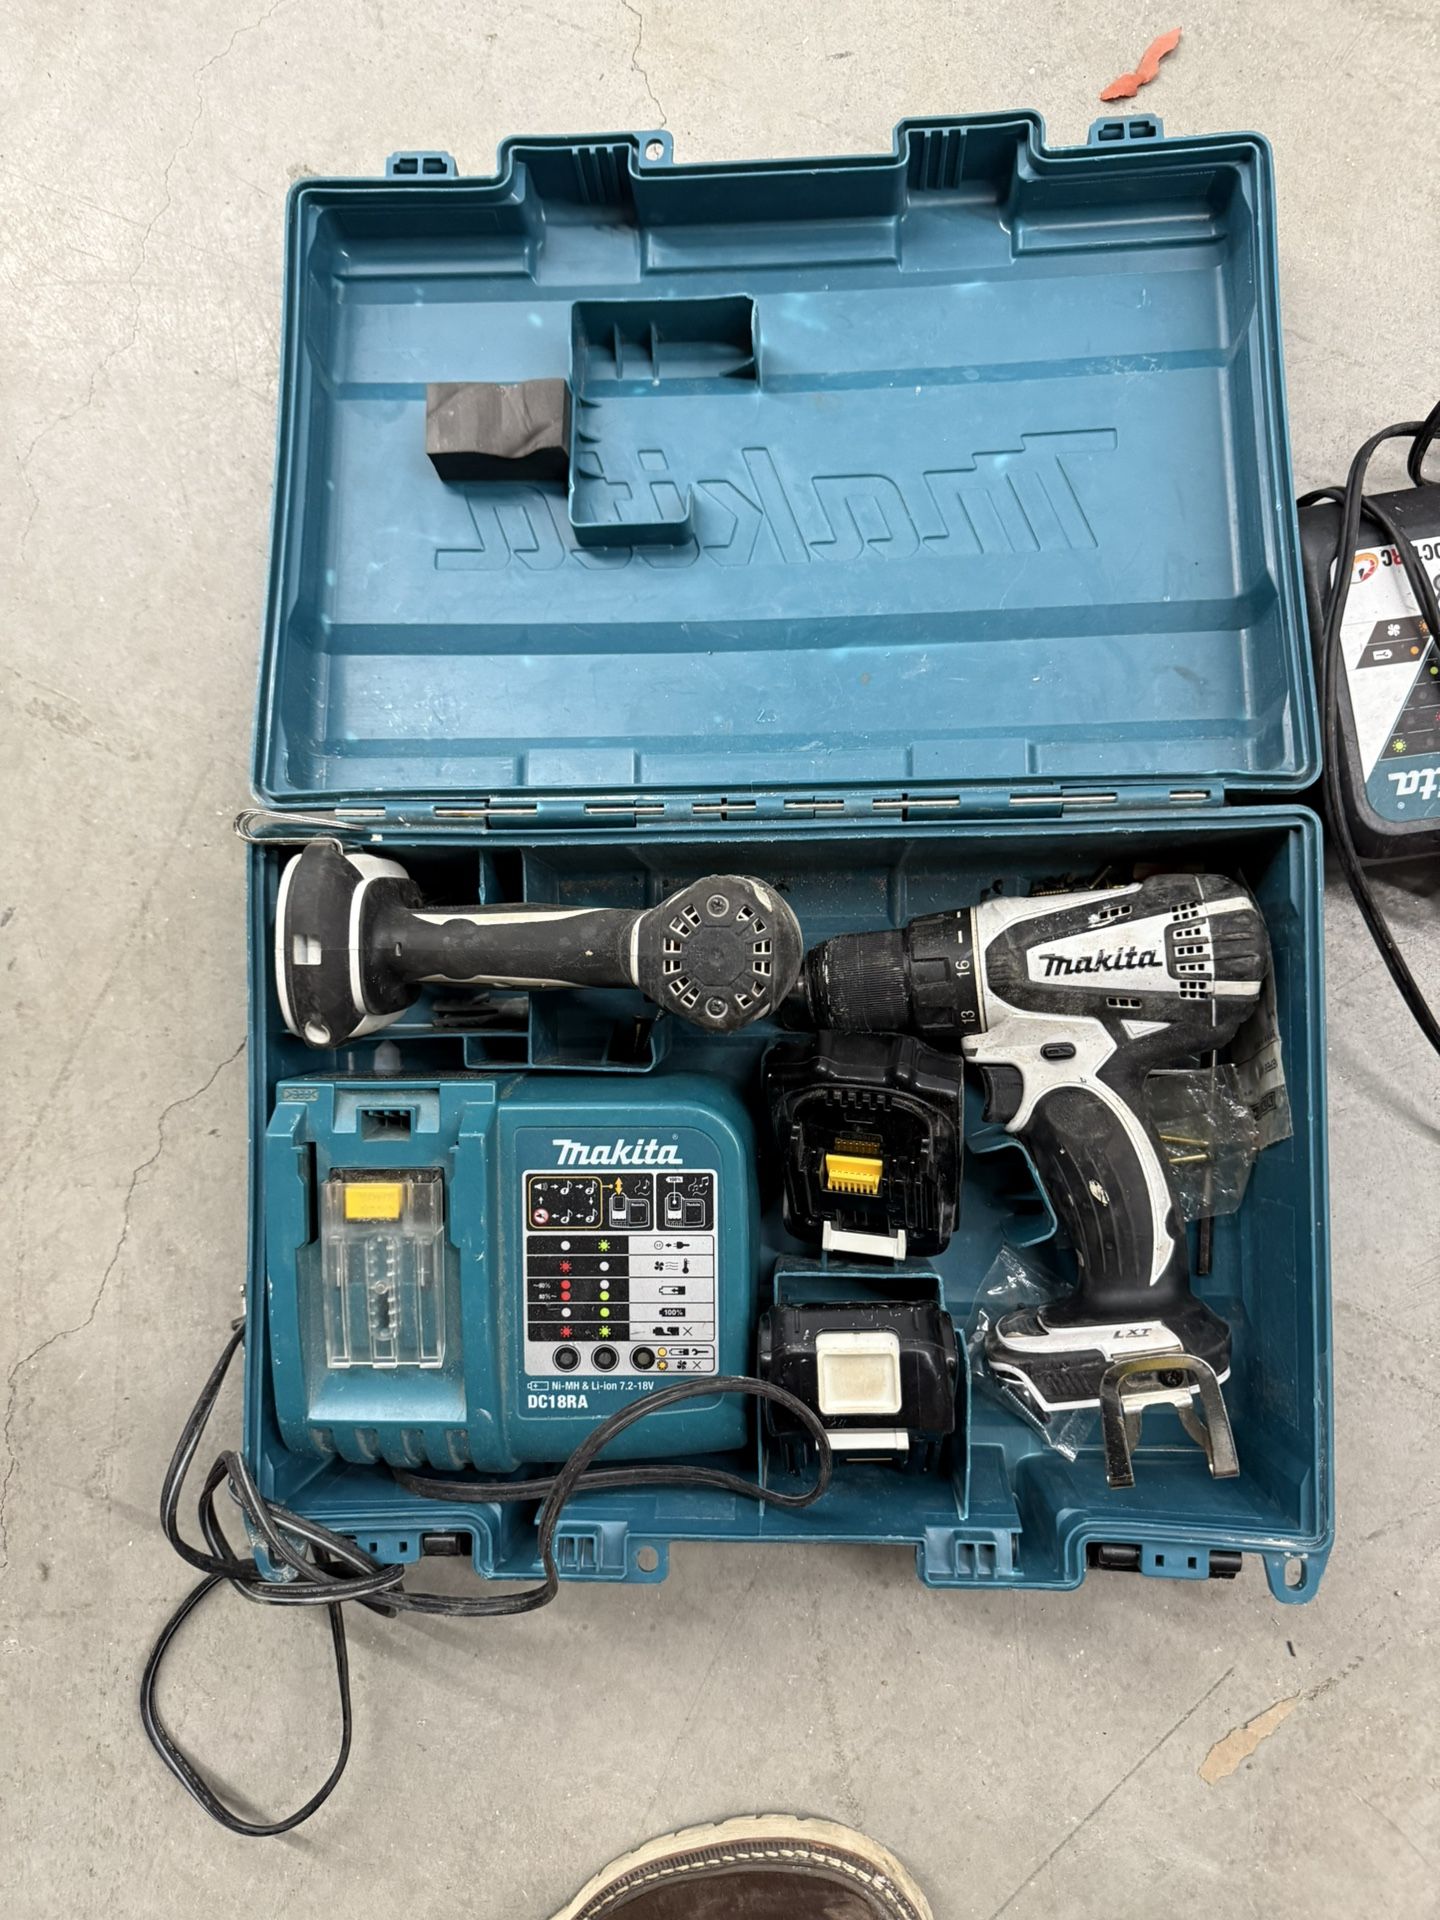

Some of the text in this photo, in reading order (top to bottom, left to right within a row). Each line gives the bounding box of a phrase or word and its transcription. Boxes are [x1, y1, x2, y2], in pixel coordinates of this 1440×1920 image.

[955, 960, 970, 978] 16
[1038, 946, 1163, 977] Makita
[961, 1009, 976, 1025] 13
[552, 1138, 683, 1165] Makita
[1113, 1328, 1152, 1339] LXT
[551, 1381, 654, 1390] Ni-MH & Li-ion 7.2-18V
[527, 1394, 589, 1409] DC18RA
